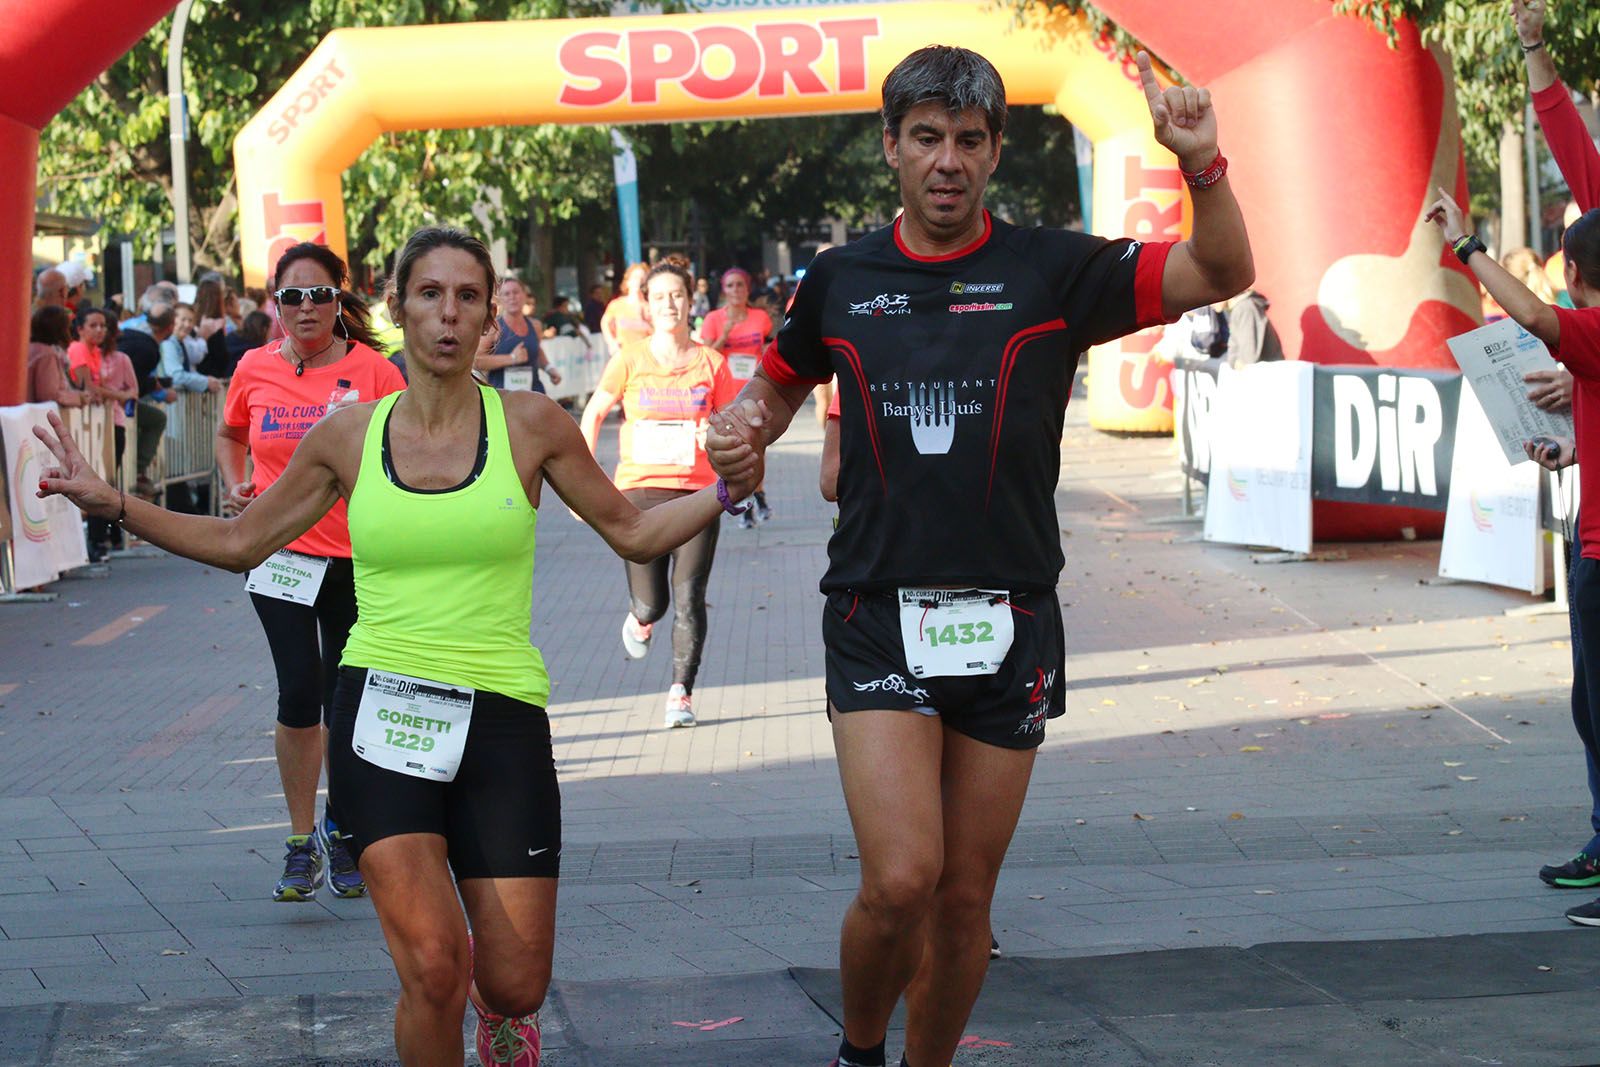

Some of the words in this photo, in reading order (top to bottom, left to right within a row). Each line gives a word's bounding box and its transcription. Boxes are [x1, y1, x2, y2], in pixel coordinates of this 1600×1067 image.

[559, 18, 879, 107] SPORT
[267, 58, 346, 145] SPORT
[966, 284, 1002, 292] INVERSE
[870, 379, 996, 392] RESTAURANT
[292, 405, 327, 418] CURS
[882, 401, 933, 421] Banys
[940, 400, 983, 416] Lluís
[1333, 373, 1443, 496] DiR
[265, 561, 313, 579] CRISCTINA
[272, 572, 301, 588] 1127
[925, 621, 994, 647] 1432
[398, 681, 418, 695] DiR
[377, 708, 451, 733] GORETTI
[385, 728, 435, 752] 1229
